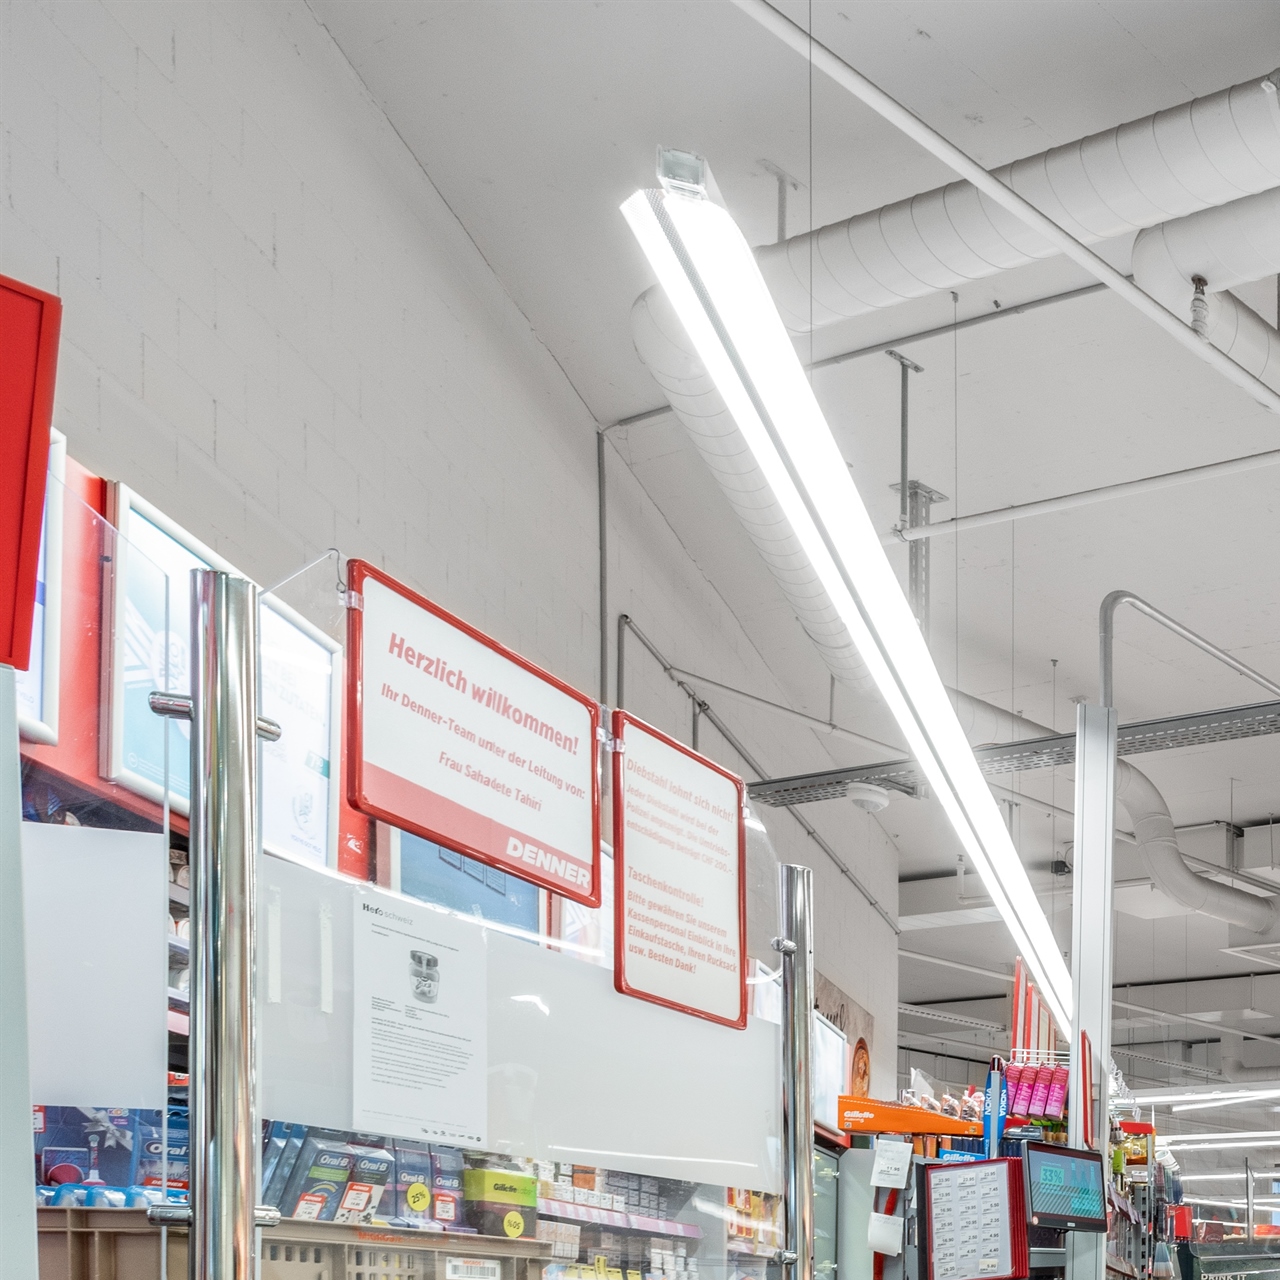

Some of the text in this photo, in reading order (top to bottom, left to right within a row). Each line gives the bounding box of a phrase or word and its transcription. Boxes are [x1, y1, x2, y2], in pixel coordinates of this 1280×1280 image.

[388, 632, 579, 755] Herzlich willkommen!
[381, 683, 586, 800] Ihr Denner-Team unter der Leitung von:
[438, 751, 543, 812] Frau Sahadete Tahiri
[626, 758, 735, 824] Diebstahl lohnt sich nicht!
[506, 836, 591, 888] DENNER
[628, 866, 705, 908] Taschenkontrolle!
[362, 903, 414, 926] Hero schweiz
[627, 890, 646, 906] Bitte
[647, 900, 685, 923] gewähren
[685, 914, 697, 926] Sie
[627, 907, 687, 938] Kassenpersonal
[687, 931, 715, 949] Einblick
[628, 925, 738, 973] Einkaufstasche, Ihren Rucksack
[629, 944, 697, 975] usw. Besten Dank!
[999, 1089, 1007, 1117] NOKIA
[320, 1154, 350, 1167] Oral-B
[360, 1160, 388, 1172] Oral-B
[943, 1153, 976, 1162] Gillette
[401, 1173, 425, 1183] Oral-B
[436, 1177, 459, 1188] Oral-B
[493, 1183, 518, 1193] Gillette
[1042, 1169, 1063, 1184] 33%
[411, 1191, 426, 1204] 25%
